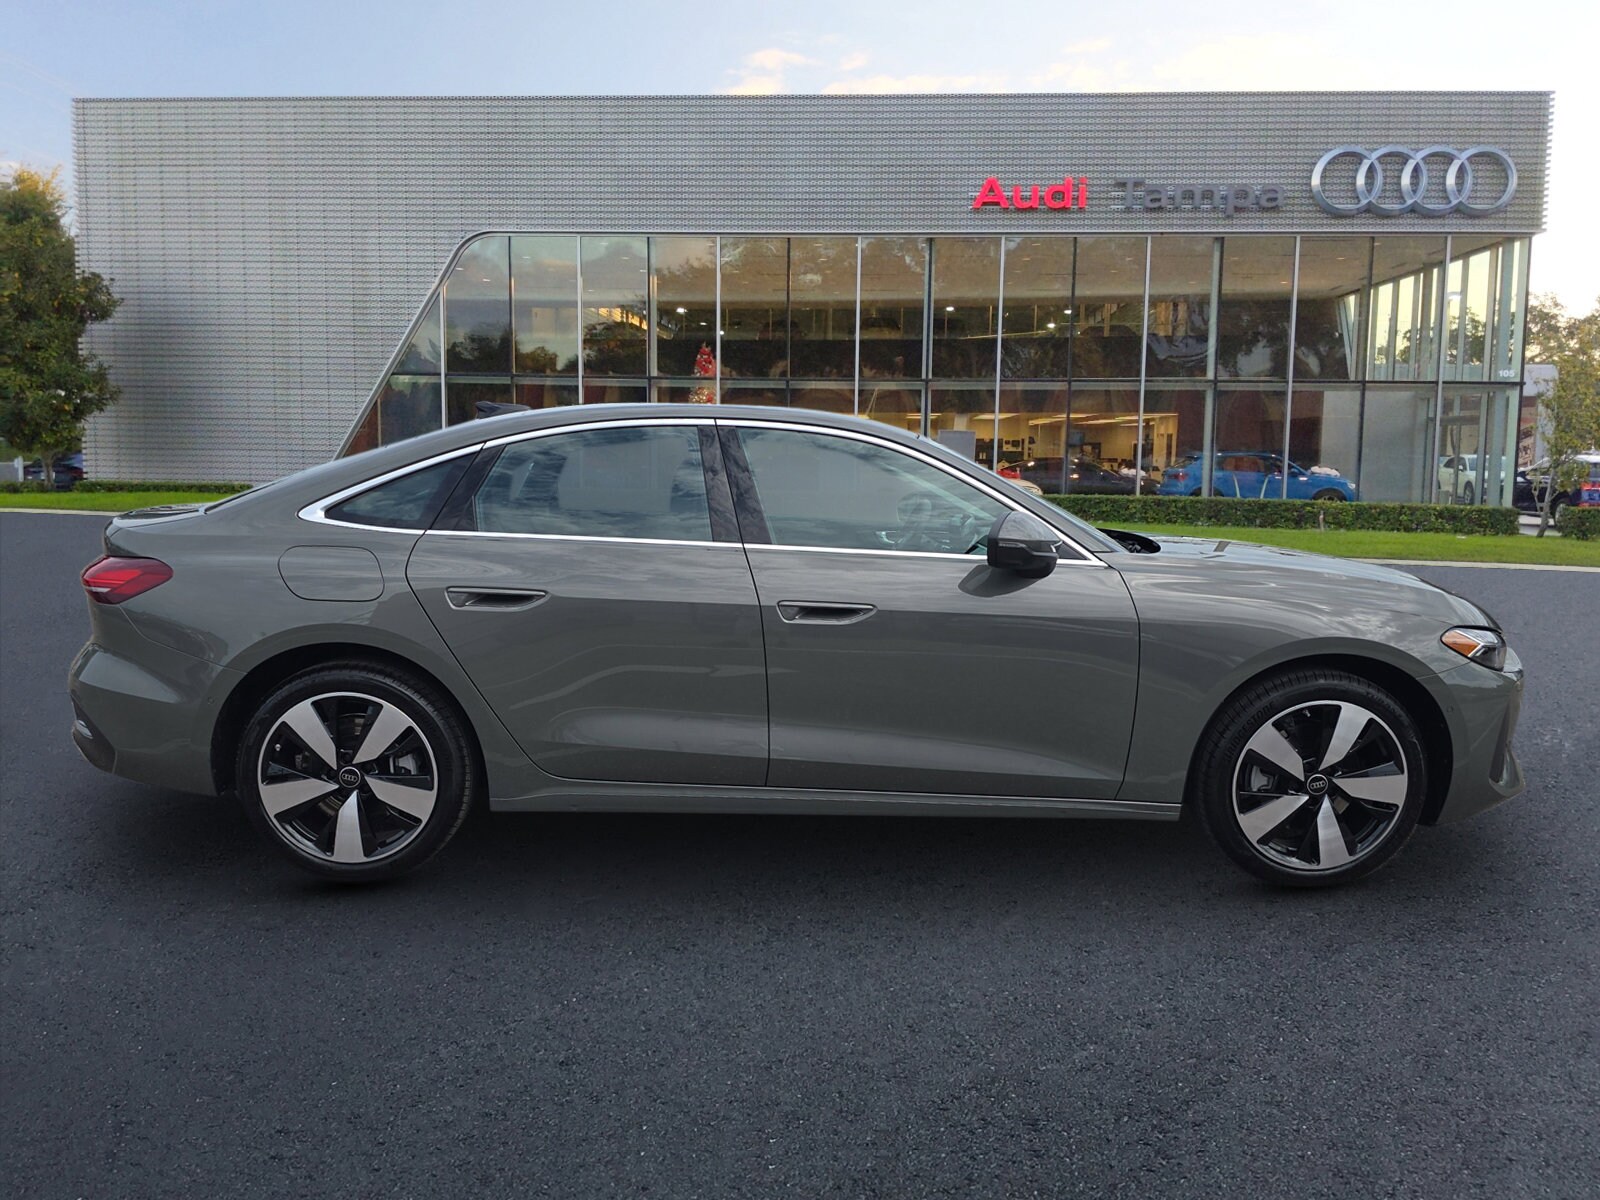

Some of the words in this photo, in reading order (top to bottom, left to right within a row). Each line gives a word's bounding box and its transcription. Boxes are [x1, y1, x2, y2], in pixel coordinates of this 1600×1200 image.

[972, 177, 1088, 209] Audi
[1115, 177, 1286, 217] Tampa
[1499, 369, 1515, 378] 105
